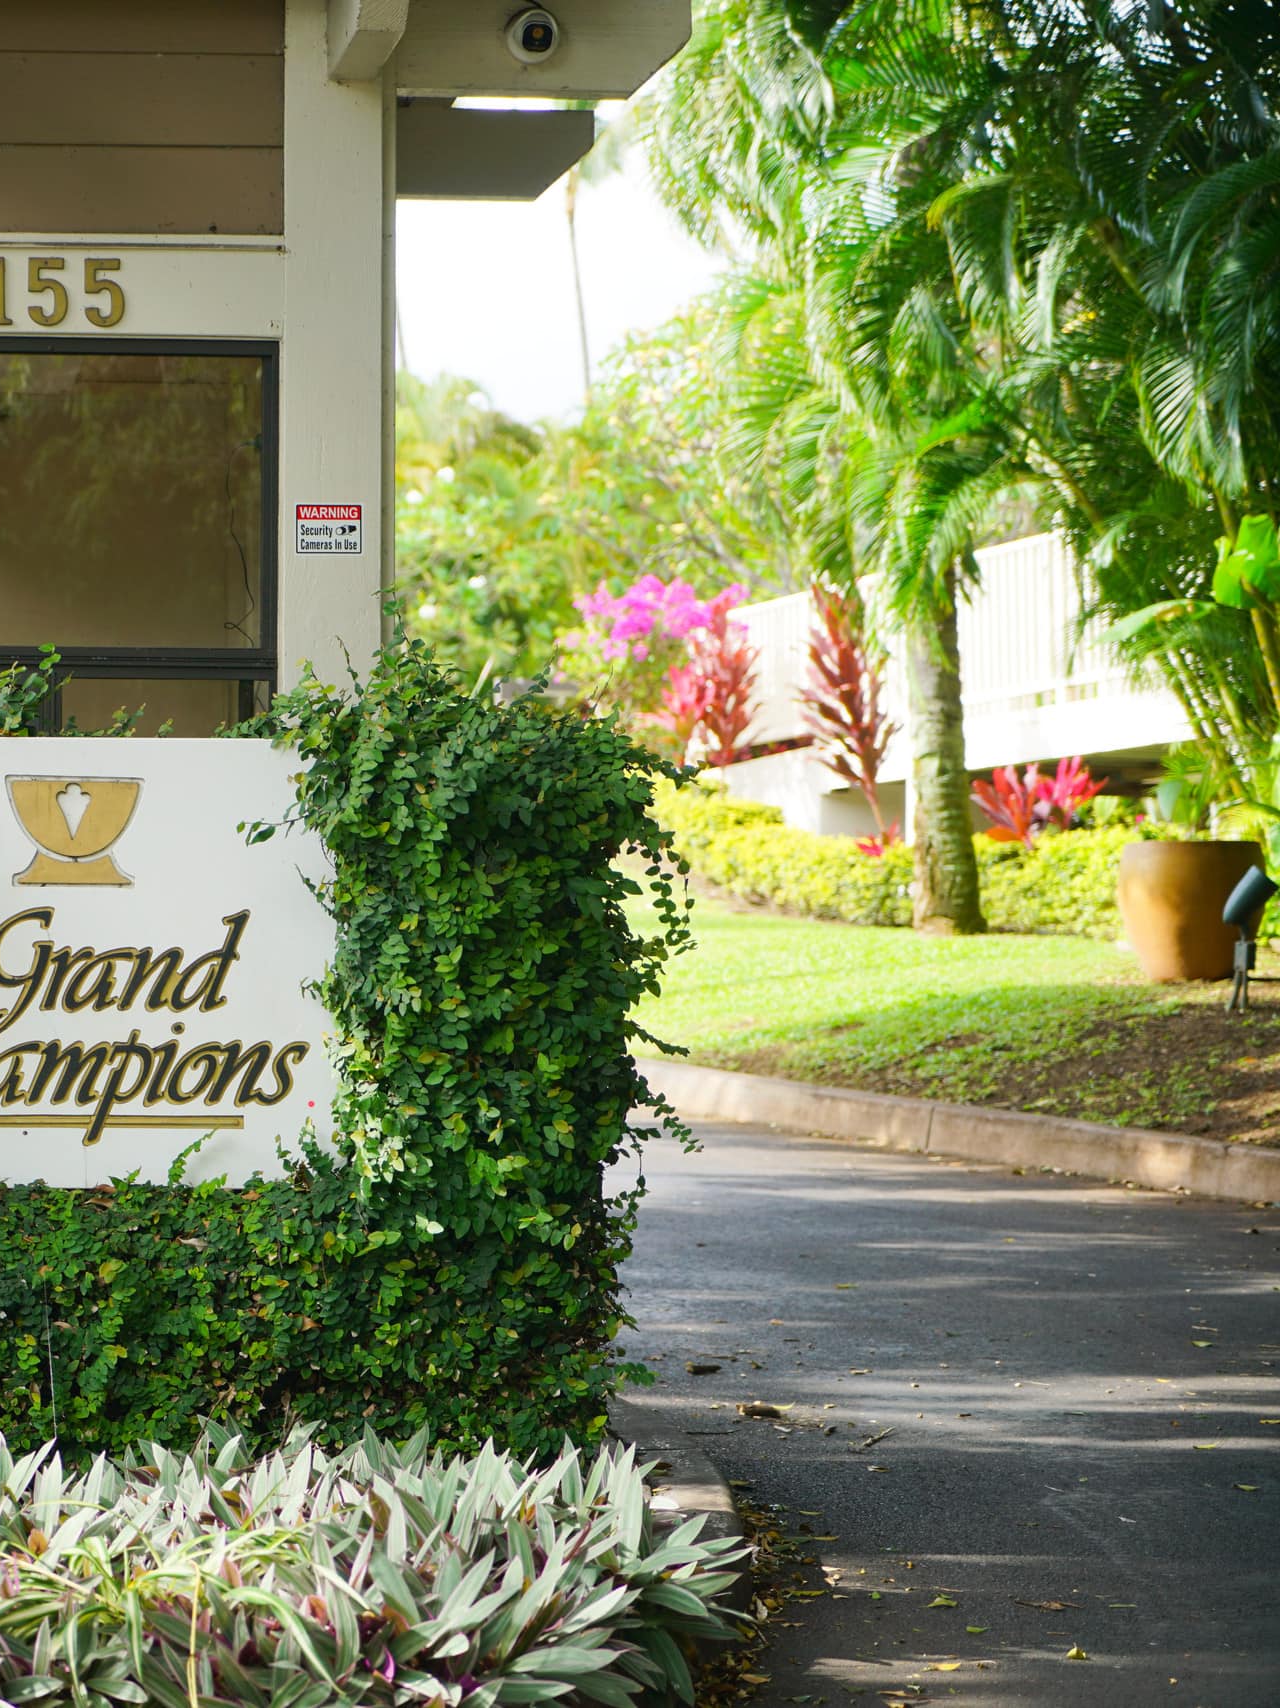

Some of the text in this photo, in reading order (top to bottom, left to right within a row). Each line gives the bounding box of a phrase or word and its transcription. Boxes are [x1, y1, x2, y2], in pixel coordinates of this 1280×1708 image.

[300, 506, 358, 519] WARNING
[300, 524, 333, 538] Security
[300, 539, 358, 550] Cameras In Use
